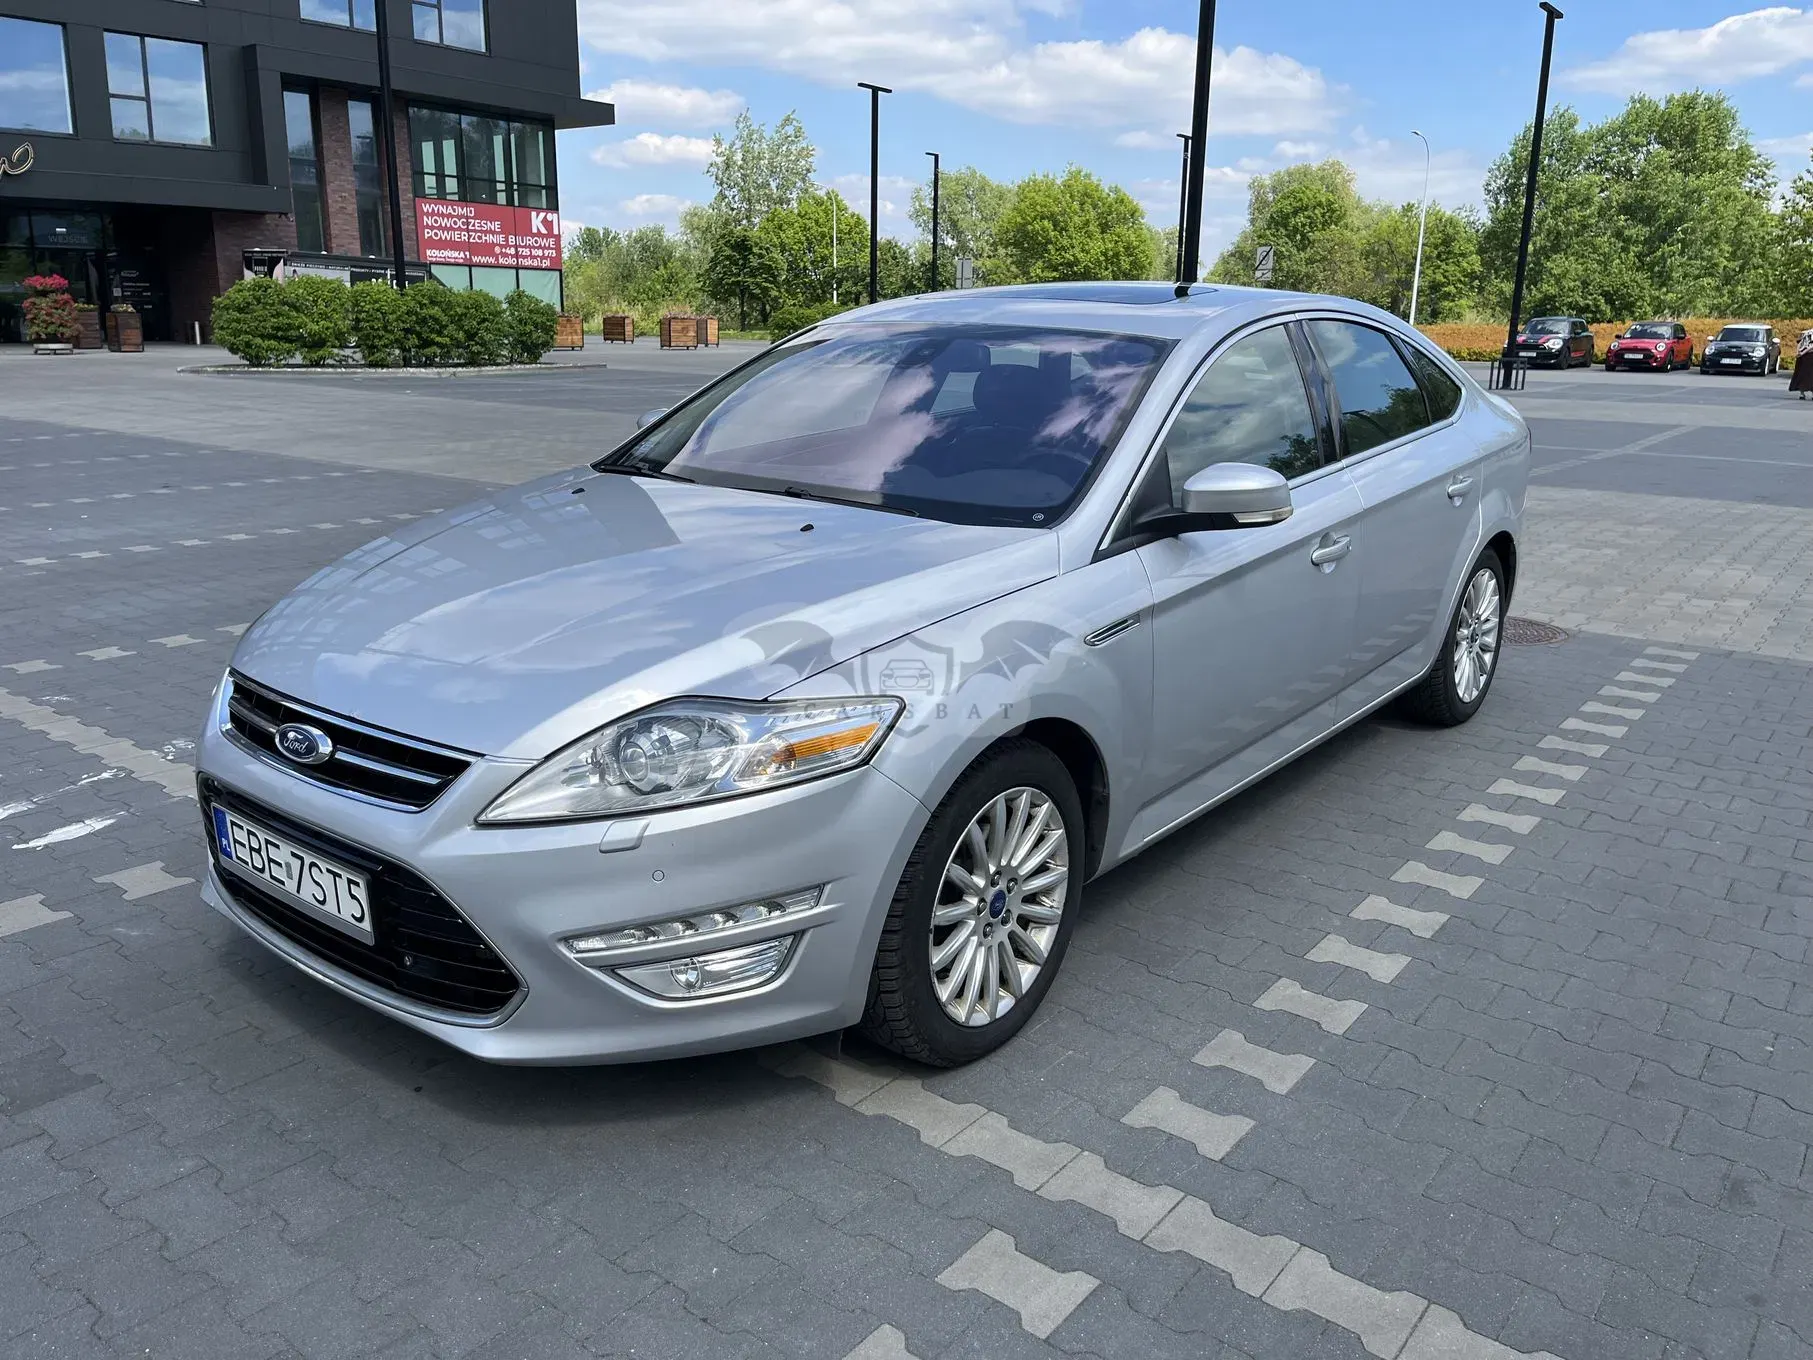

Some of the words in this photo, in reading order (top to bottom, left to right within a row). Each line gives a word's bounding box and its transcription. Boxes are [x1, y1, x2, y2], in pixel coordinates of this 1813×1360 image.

[422, 203, 474, 216] WYNAJMIJ
[423, 216, 501, 231] NOWOCZESNE
[424, 229, 506, 244] POWIERZCHNIE
[508, 235, 556, 247] BIUROWE
[283, 731, 307, 753] Ford
[221, 837, 230, 851] PL
